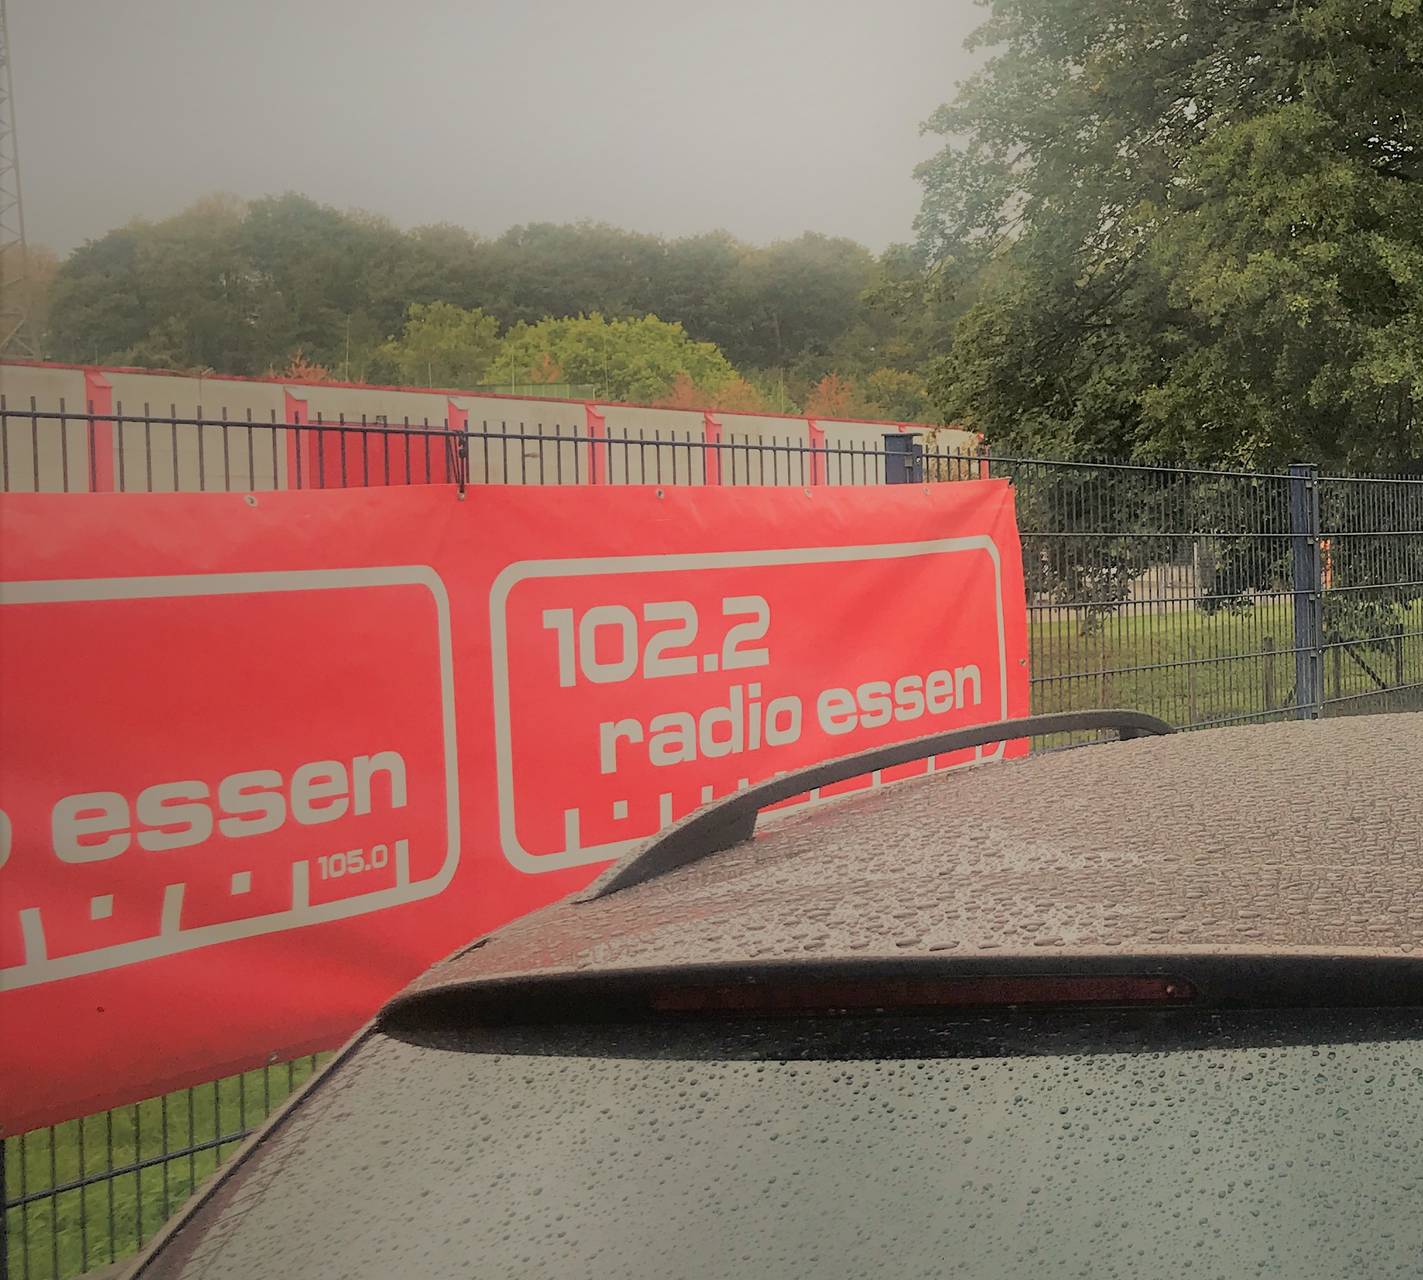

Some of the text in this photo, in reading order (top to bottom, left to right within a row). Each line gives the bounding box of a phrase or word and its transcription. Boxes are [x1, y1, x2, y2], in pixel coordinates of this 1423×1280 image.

[543, 595, 770, 687] 102.2
[599, 664, 982, 774] radio essen
[51, 750, 408, 864] essen
[318, 844, 388, 880] 105.0
